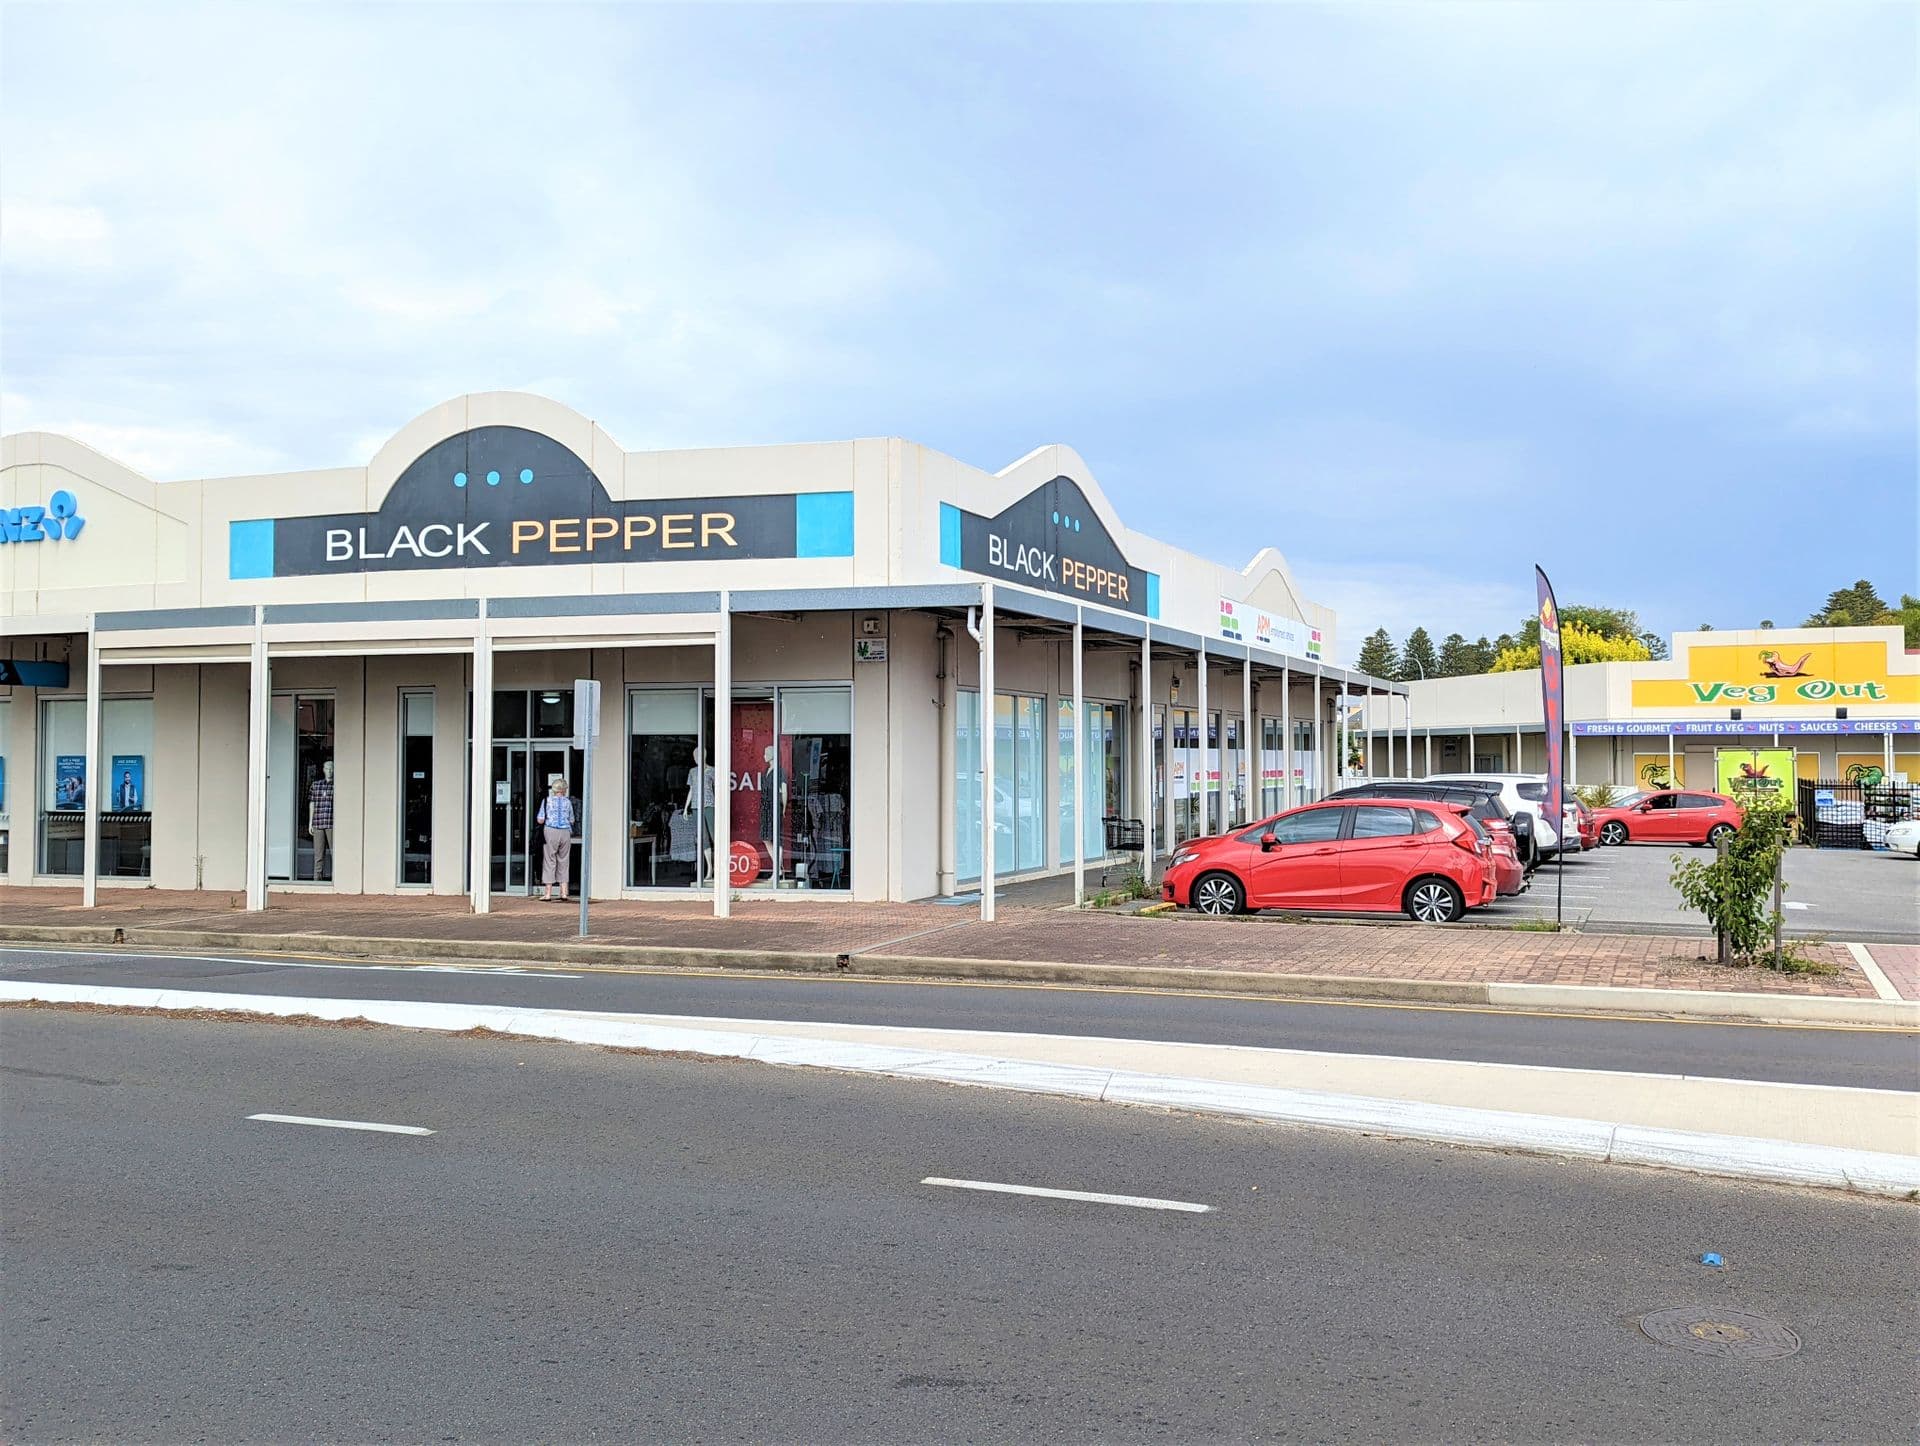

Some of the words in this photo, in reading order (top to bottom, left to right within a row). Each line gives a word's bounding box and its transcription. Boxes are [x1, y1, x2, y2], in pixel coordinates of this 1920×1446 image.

[325, 522, 490, 562] BLACK
[511, 512, 738, 554] PEPPER
[989, 533, 1056, 582] BLACK
[1062, 557, 1129, 602] PEPPER
[1690, 682, 1778, 703] Veg
[1797, 680, 1887, 700] Out
[1587, 725, 1615, 733] FRESH
[1616, 724, 1624, 733] &
[1626, 724, 1671, 733] GOURMET
[1686, 724, 1712, 732] FRUIT
[1715, 724, 1725, 732] &
[1726, 724, 1744, 732] VEG
[1759, 723, 1785, 732] NUTS
[1800, 723, 1839, 732] SAUCES
[1854, 722, 1898, 731] CHEESES
